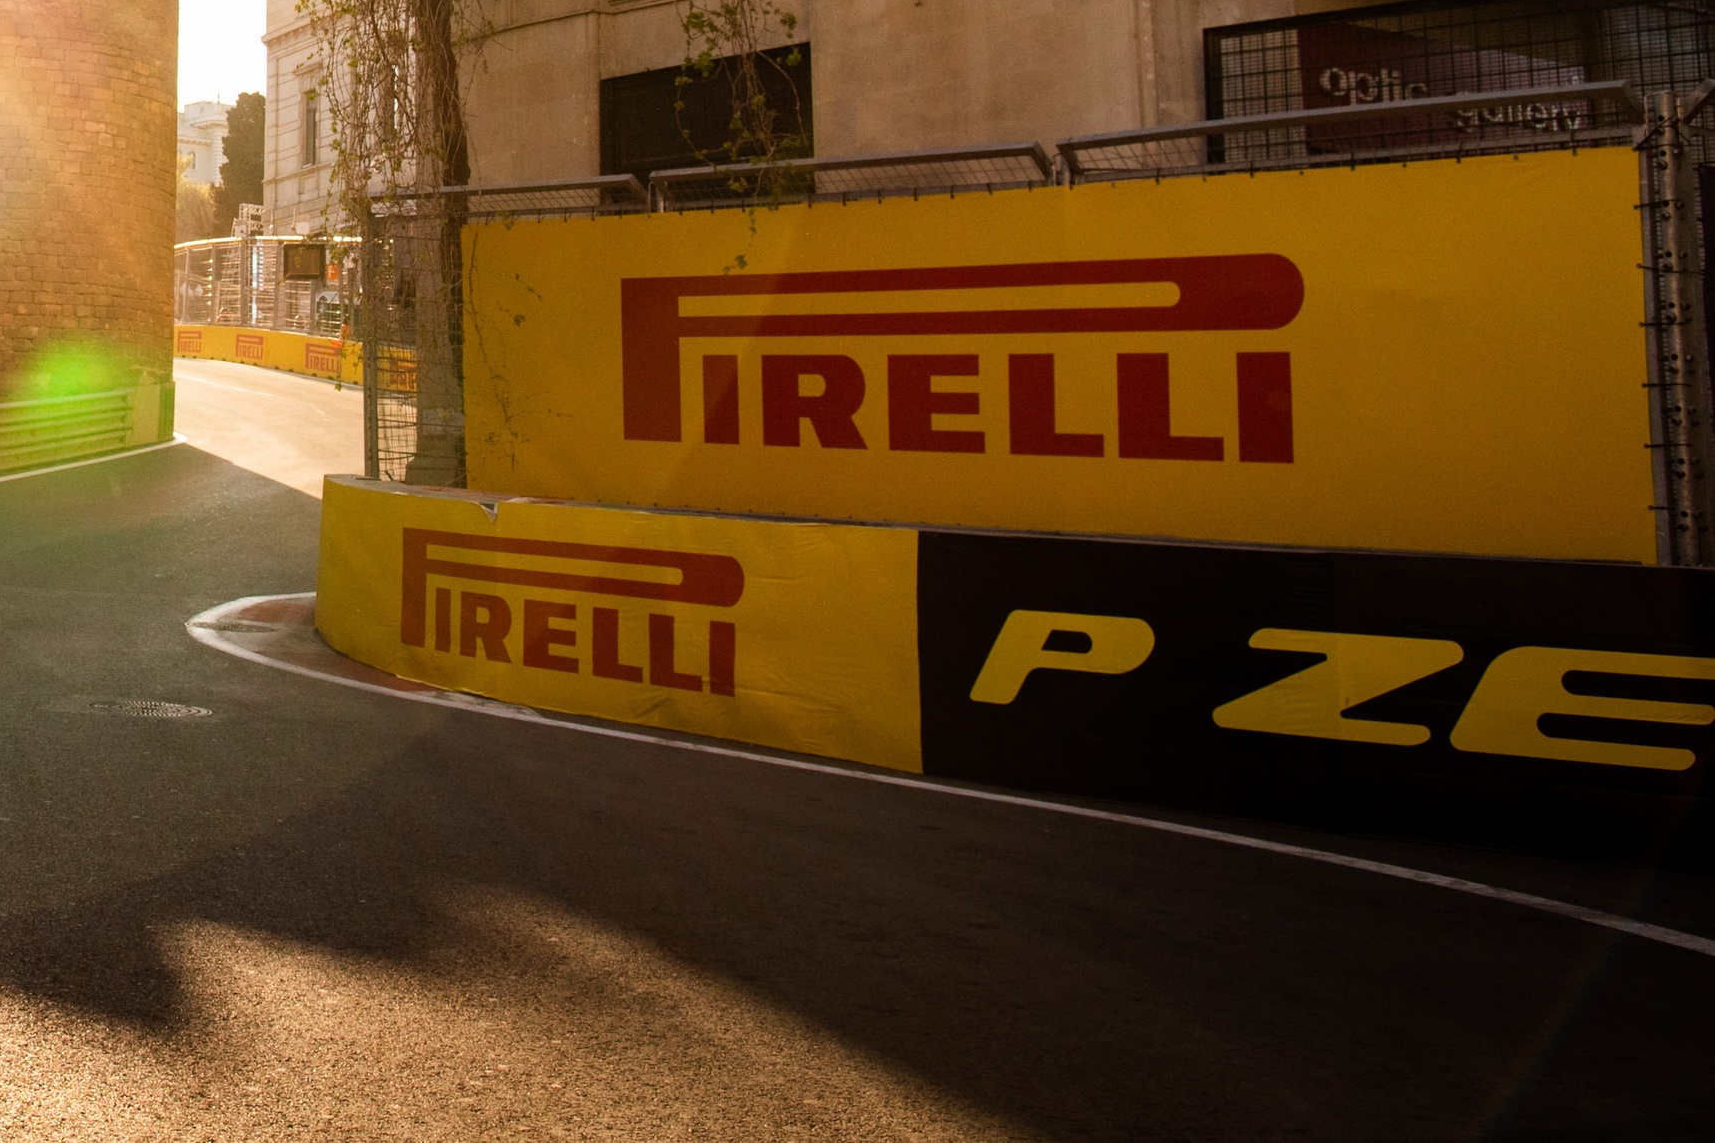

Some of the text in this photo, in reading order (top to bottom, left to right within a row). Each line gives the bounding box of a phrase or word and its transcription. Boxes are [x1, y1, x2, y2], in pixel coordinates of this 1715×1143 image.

[178, 331, 202, 353] PIRELLI
[236, 334, 264, 360] PIRELLI
[304, 343, 342, 374] PIRELLI
[621, 253, 1304, 463] PIRELLI
[401, 528, 745, 697] PIRELLI
